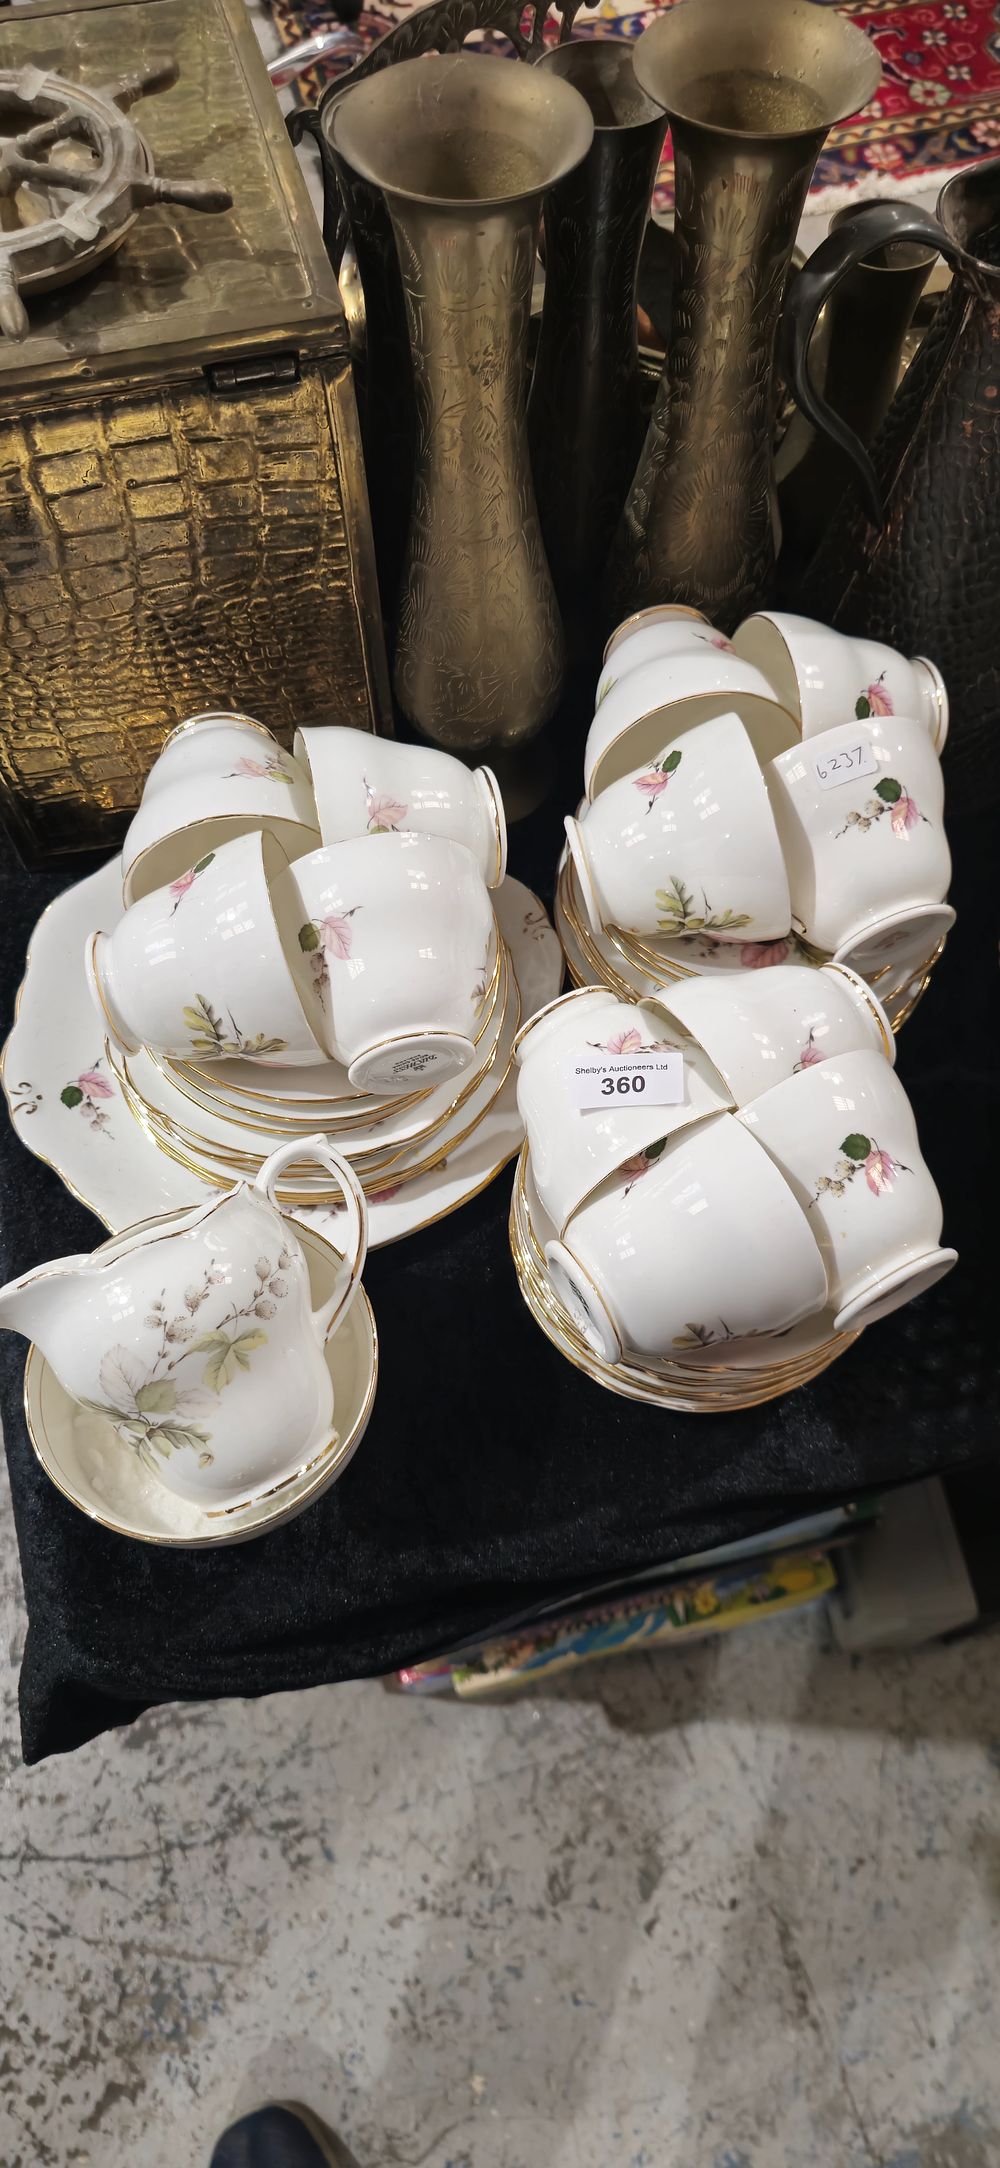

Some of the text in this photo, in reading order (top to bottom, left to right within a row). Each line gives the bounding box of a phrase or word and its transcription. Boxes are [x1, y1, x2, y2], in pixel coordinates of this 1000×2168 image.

[816, 746, 862, 779] 6237
[575, 1066, 607, 1075] Shelby's
[608, 1064, 654, 1073] Auctioneers
[601, 1075, 646, 1095] 360
